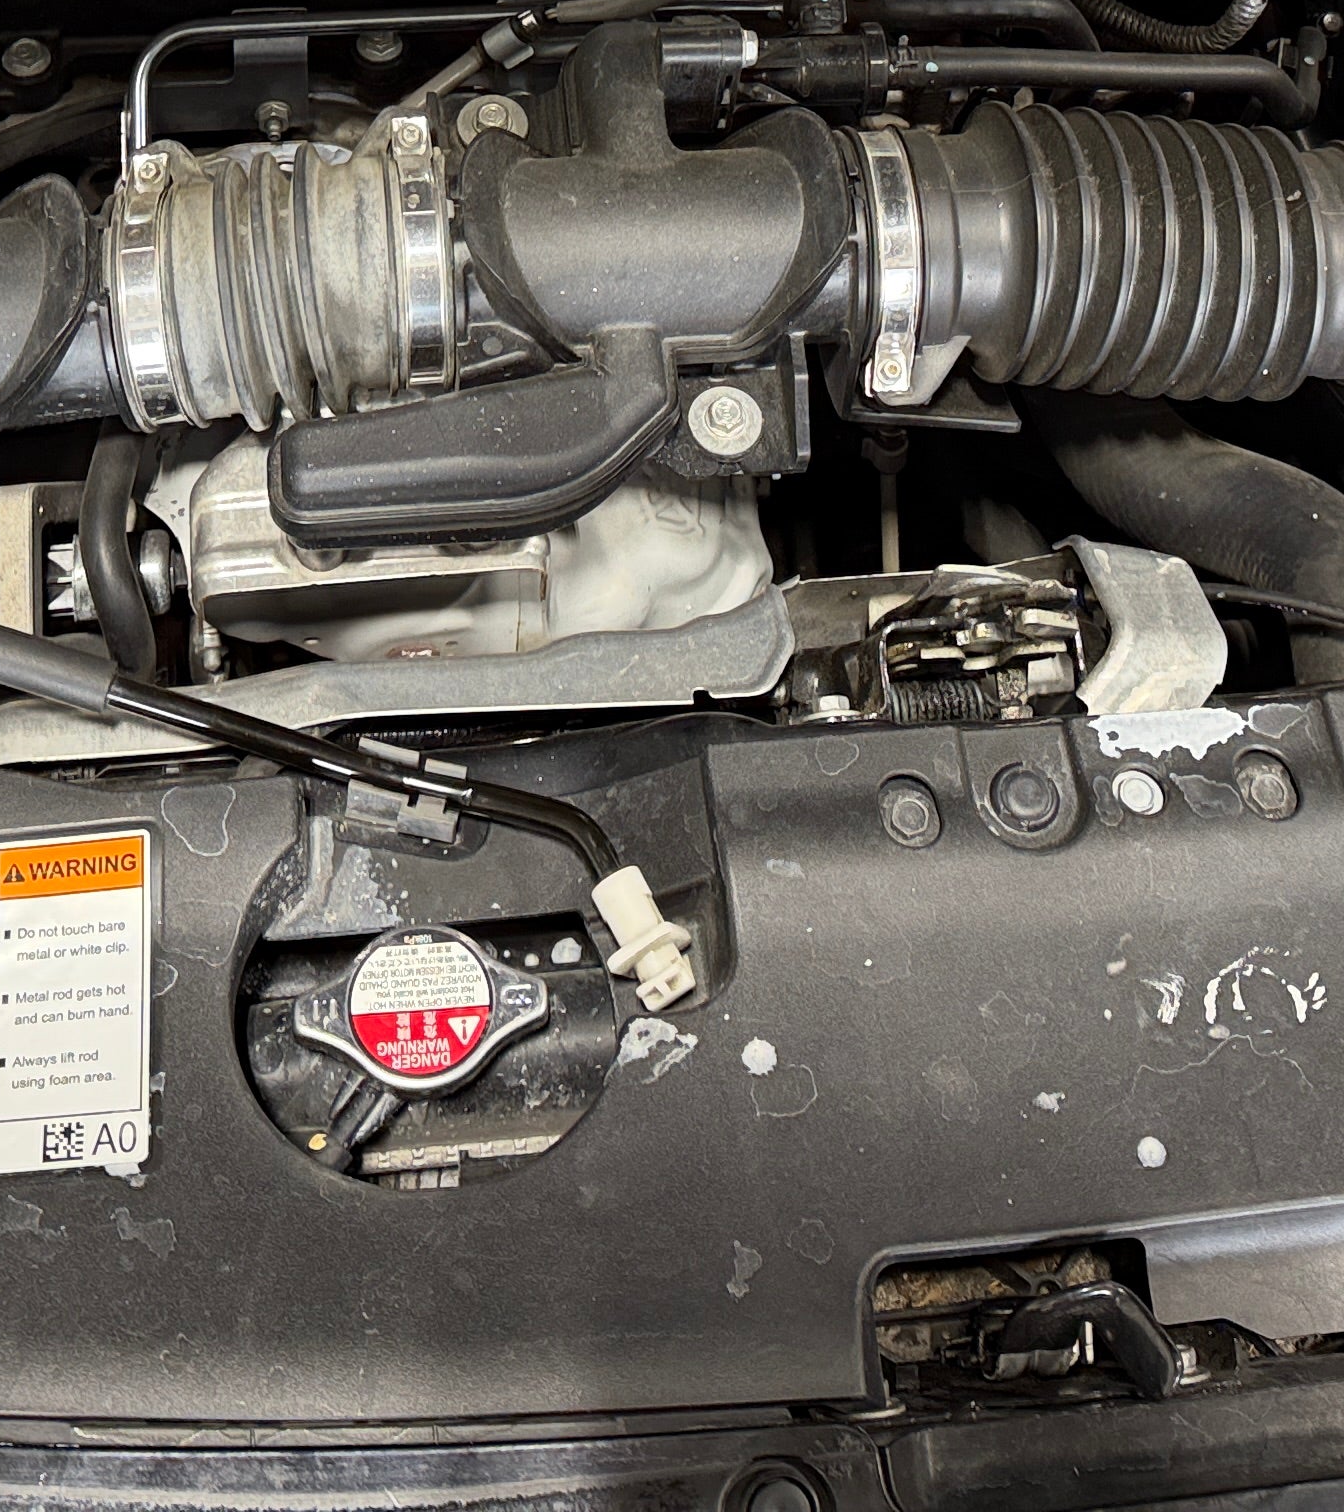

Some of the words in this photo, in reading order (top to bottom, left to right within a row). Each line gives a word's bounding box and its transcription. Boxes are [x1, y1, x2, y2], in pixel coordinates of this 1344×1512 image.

[29, 853, 137, 880] WARNING
[18, 927, 36, 939] Do
[38, 925, 58, 938] not
[61, 922, 95, 936] touch
[98, 920, 125, 934] bare
[17, 948, 51, 961] metal
[54, 949, 67, 959] or
[70, 945, 102, 956] white
[105, 942, 130, 956] clip.
[391, 978, 420, 988] QUAND
[422, 978, 438, 986] PAS
[16, 991, 50, 1004] Metal
[53, 988, 73, 1001] rod
[76, 987, 103, 1002] gets
[106, 985, 125, 996] hot
[418, 998, 442, 1007] OPEN
[444, 996, 475, 1006] NEVER
[388, 1000, 415, 1009] WHEN
[14, 1013, 38, 1025] and
[41, 1012, 64, 1023] can
[68, 1008, 96, 1021] burn
[98, 1006, 133, 1018] hand.
[377, 1038, 450, 1056] WARNUNG
[12, 1053, 57, 1070] Always
[60, 1052, 76, 1065] lift
[79, 1050, 98, 1062] rod
[391, 1052, 451, 1069] DANGER
[12, 1076, 46, 1091] using
[49, 1074, 81, 1086] foam
[84, 1072, 115, 1084] area.
